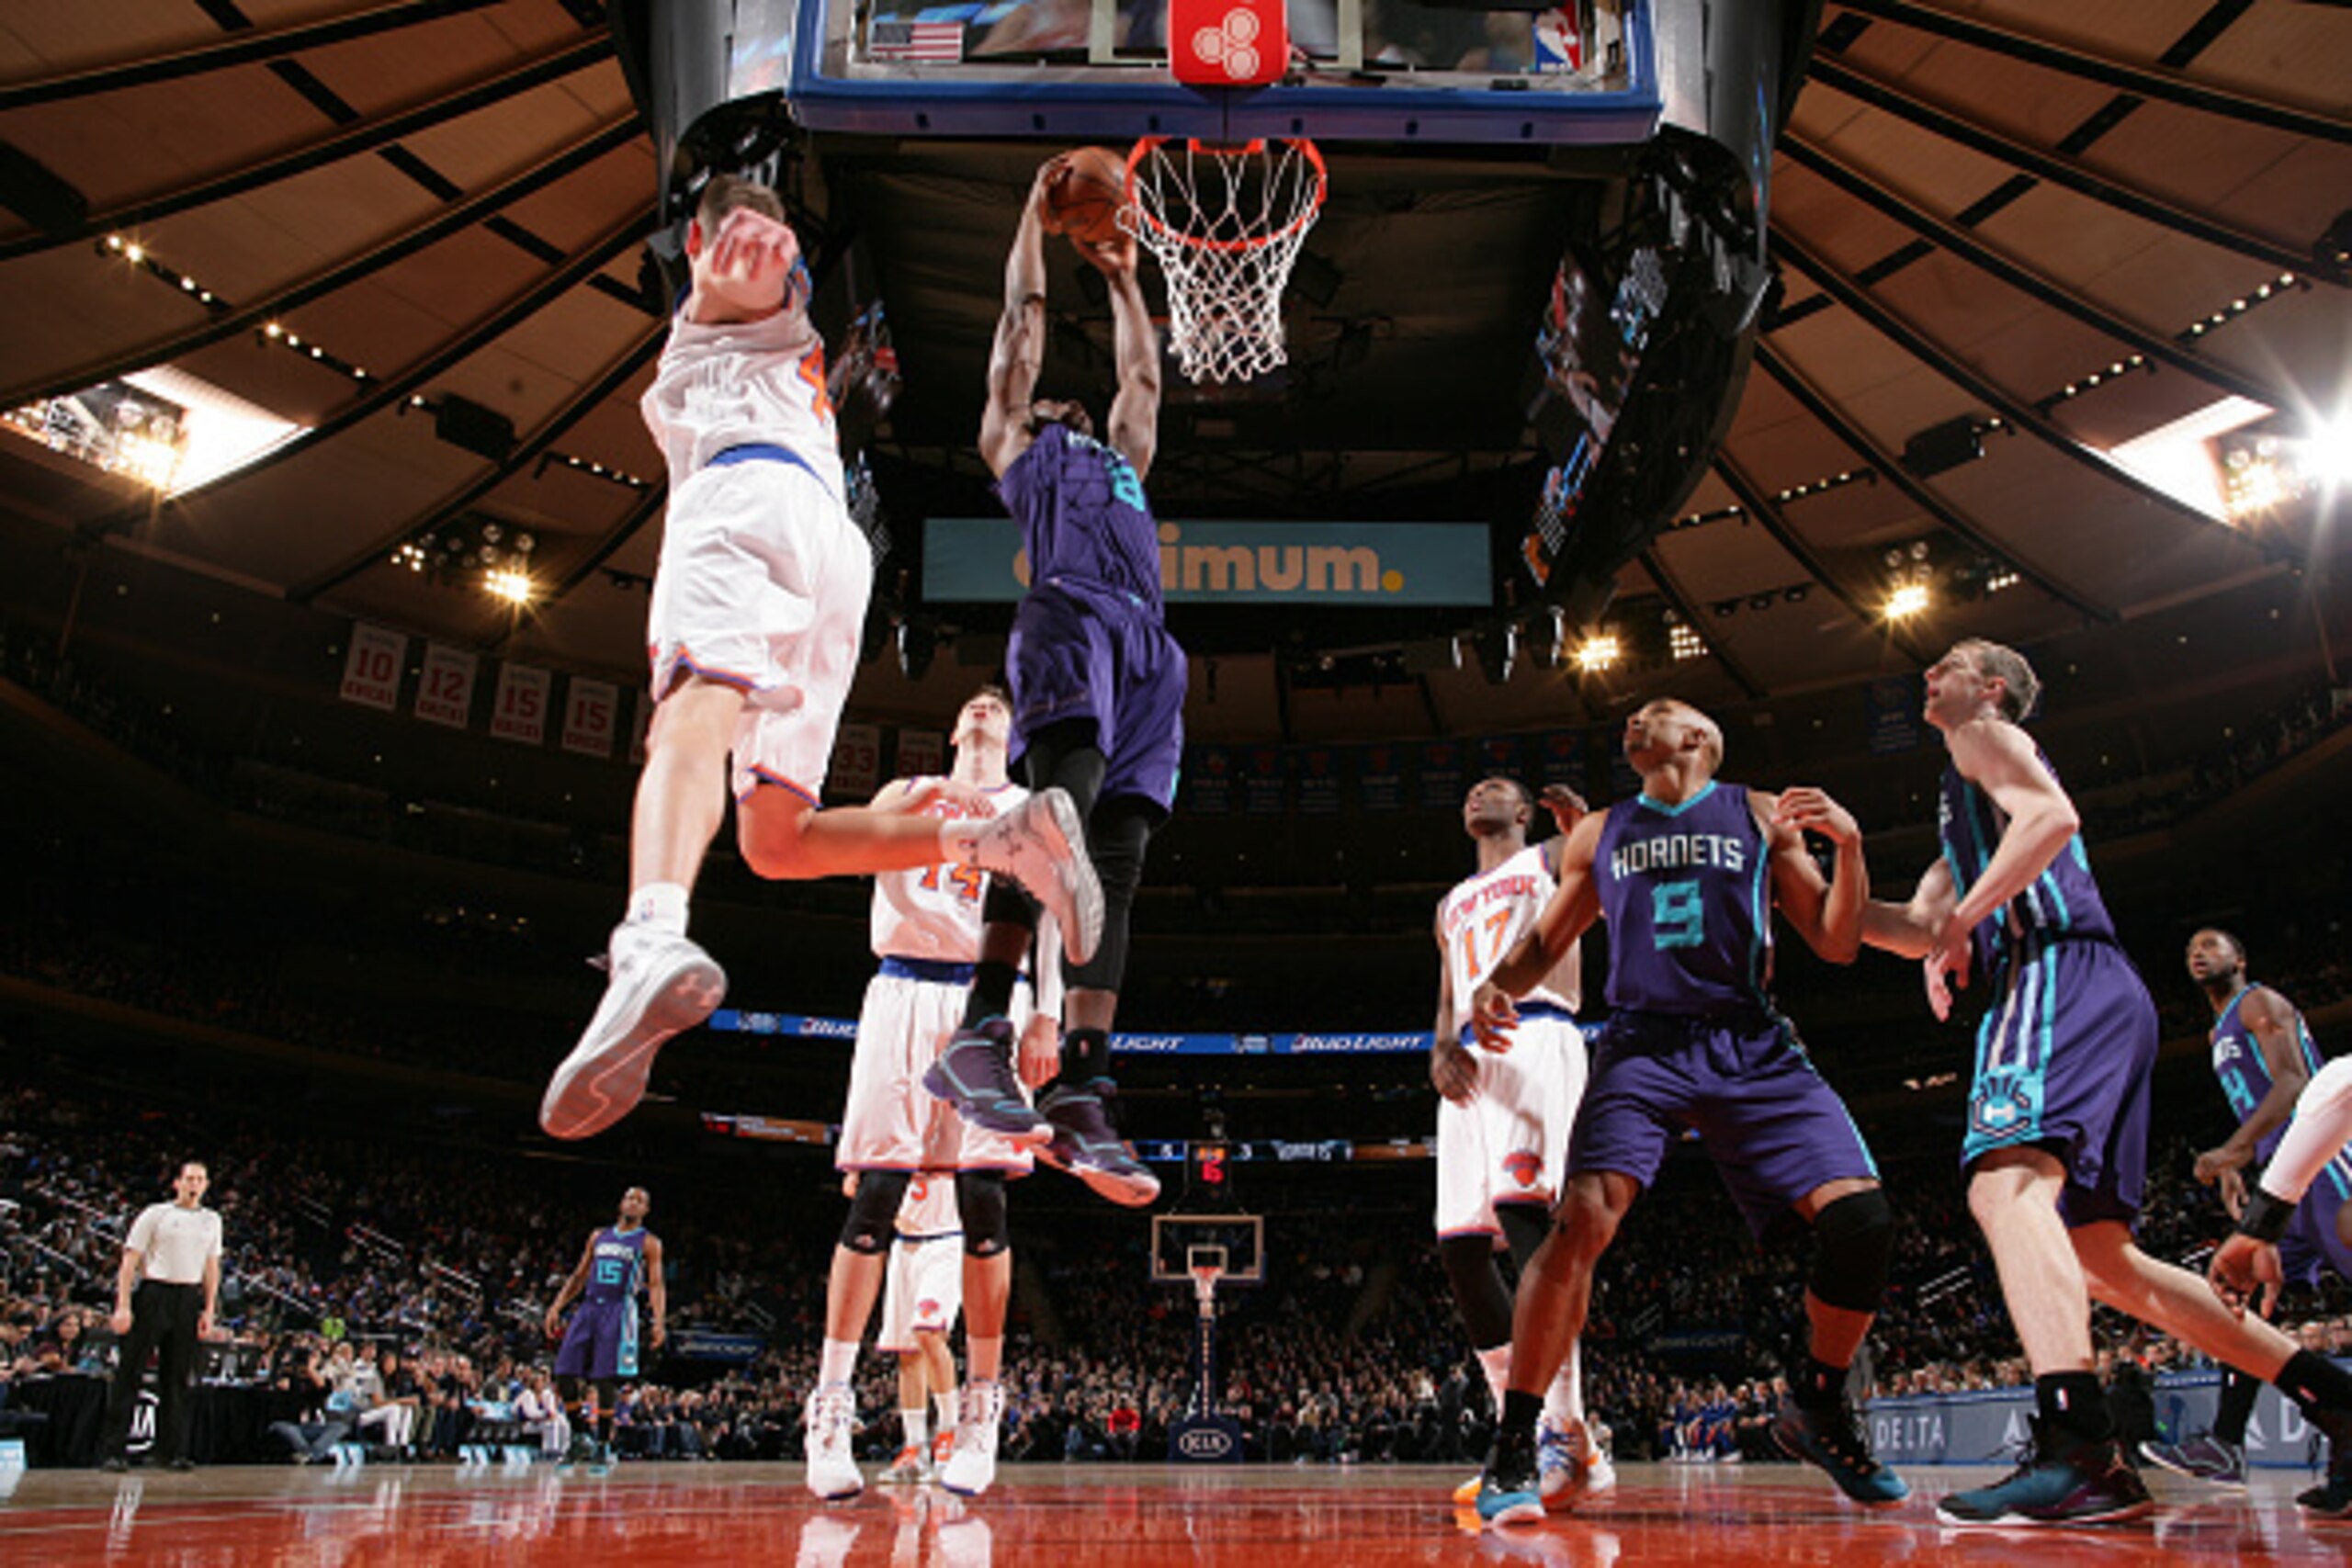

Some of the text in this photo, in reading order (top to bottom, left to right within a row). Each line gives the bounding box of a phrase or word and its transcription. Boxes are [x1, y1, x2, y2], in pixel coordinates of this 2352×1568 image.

[1013, 522, 1404, 591] imum.
[356, 647, 393, 683] 10
[428, 667, 465, 702] 12
[503, 685, 539, 718] 15
[574, 700, 607, 732] 15
[1611, 834, 1744, 880] HORNETS
[1652, 878, 1703, 951] 9
[1464, 907, 1513, 980] 17
[1110, 1034, 1185, 1051] LIGHT
[1290, 1032, 1424, 1052] BUD LIGHT
[596, 1258, 623, 1285] 15
[1875, 1416, 1946, 1450] DELTA
